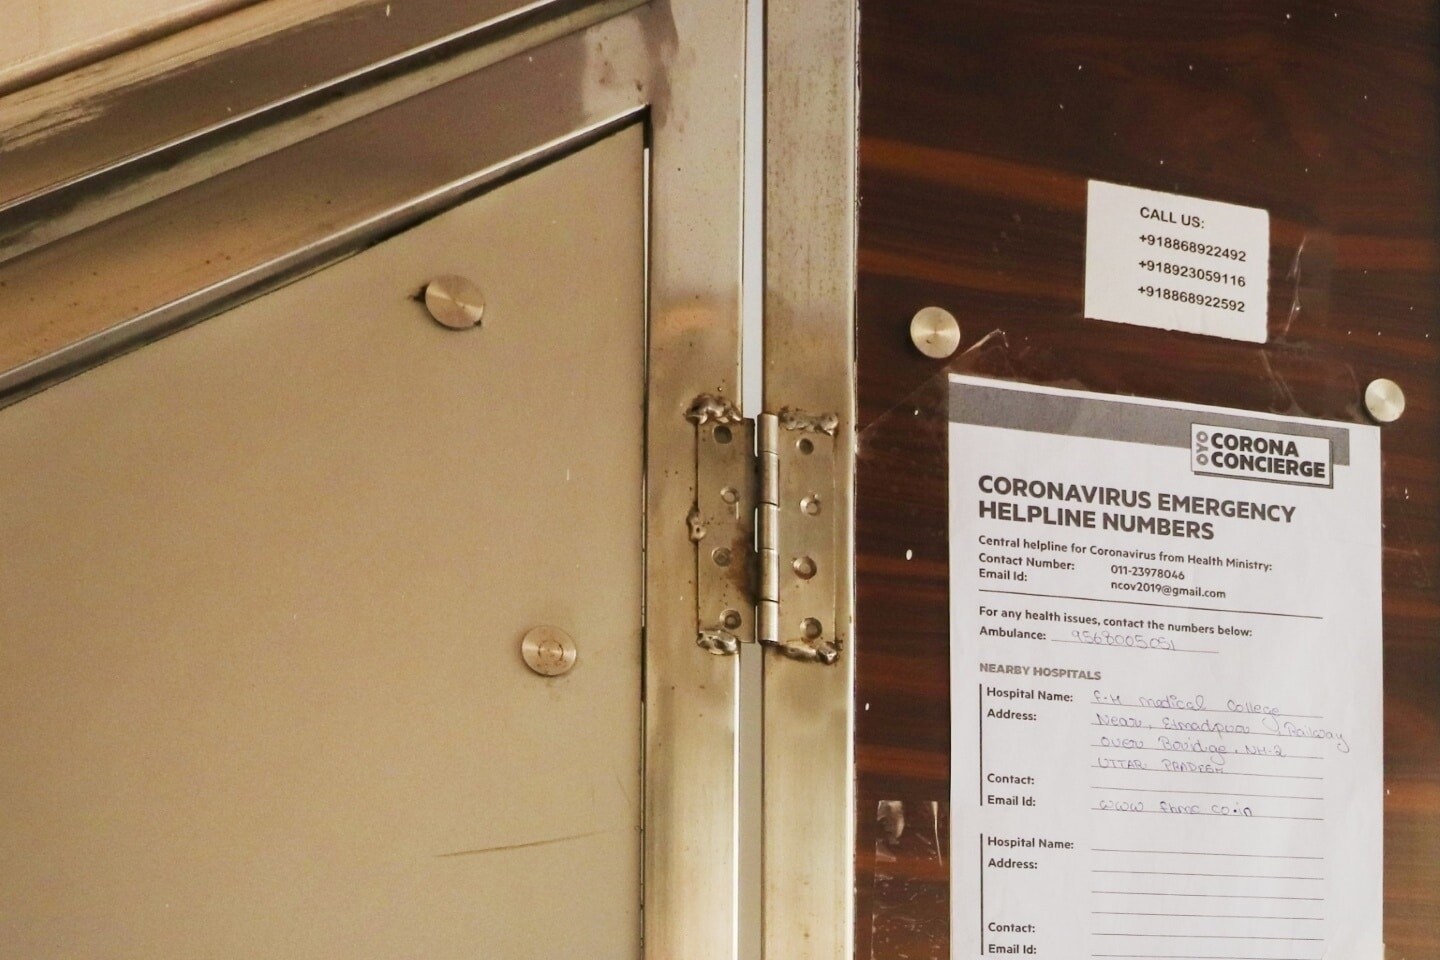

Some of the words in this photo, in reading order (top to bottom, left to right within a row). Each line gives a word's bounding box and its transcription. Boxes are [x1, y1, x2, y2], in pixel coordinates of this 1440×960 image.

[1140, 206, 1177, 224] CALL
[1181, 214, 1205, 229] US:
[1139, 234, 1247, 262] +918868922492
[1139, 260, 1246, 287] +918923059116
[1138, 286, 1245, 312] +918868922592
[1196, 430, 1209, 466] OYO
[1211, 432, 1298, 458] CORONA
[1211, 451, 1326, 478] CONCIERGE
[978, 475, 1151, 509] CORONAVIRUS
[1158, 494, 1296, 522] EMERGENCY
[978, 501, 1096, 528] HELPLINE
[1103, 513, 1214, 540] NUMBERS
[979, 536, 1020, 549] Central
[1023, 538, 1068, 555] helpline
[1071, 543, 1086, 554] for
[1090, 545, 1156, 561] Coronavirus
[1159, 549, 1184, 563] from
[1187, 553, 1223, 567] Health
[1226, 557, 1272, 573] Ministry:
[979, 554, 1022, 567] Contact
[1026, 558, 1075, 571] Number:
[1111, 565, 1185, 580] 011-23978046
[979, 569, 1009, 581] Email
[1012, 571, 1027, 582] Id:
[1111, 580, 1226, 599] ncov2019@gmail.com
[979, 607, 998, 618] For
[1001, 610, 1022, 621] any
[1025, 610, 1060, 623] health
[1063, 613, 1100, 626] issues,
[1103, 616, 1144, 629] contact
[1147, 619, 1165, 631] the
[1168, 621, 1215, 634] numbers
[1218, 623, 1252, 637] below:
[979, 626, 1046, 641] Ambulance:
[979, 663, 1030, 677] NEARBY
[1033, 667, 1102, 680] HOSPITALS
[987, 687, 1034, 702] Hospital
[1038, 690, 1073, 702] Name:
[987, 708, 1037, 721] Address:
[988, 773, 1035, 785] Contact:
[988, 795, 1019, 806] Email
[1022, 796, 1036, 806] Id:
[988, 837, 1035, 849] Hospital
[1038, 839, 1074, 850] Name:
[988, 858, 1038, 870] Address:
[988, 922, 1036, 934] Contact:
[988, 944, 1021, 955] Email
[1023, 944, 1037, 955] Id:
